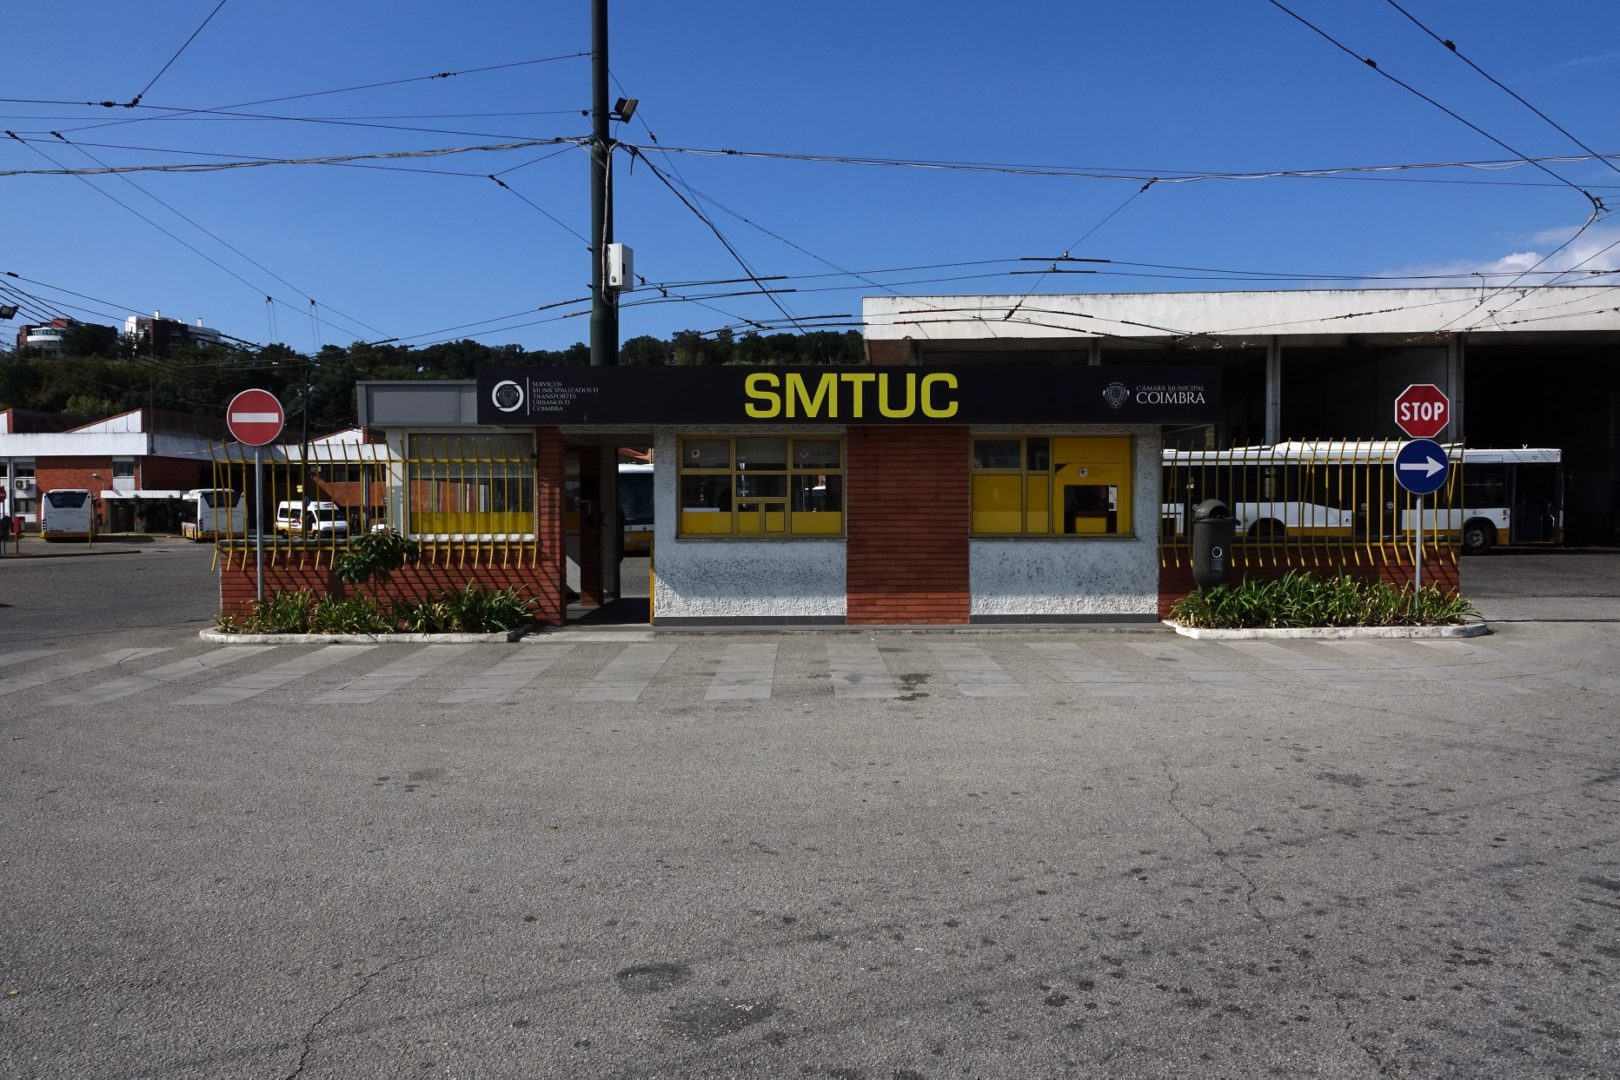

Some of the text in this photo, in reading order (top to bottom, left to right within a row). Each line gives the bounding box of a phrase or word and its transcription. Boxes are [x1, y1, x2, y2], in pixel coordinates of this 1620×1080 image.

[745, 372, 959, 418] SMTUC
[1136, 391, 1206, 404] COIMBRA
[1400, 402, 1445, 421] STOP
